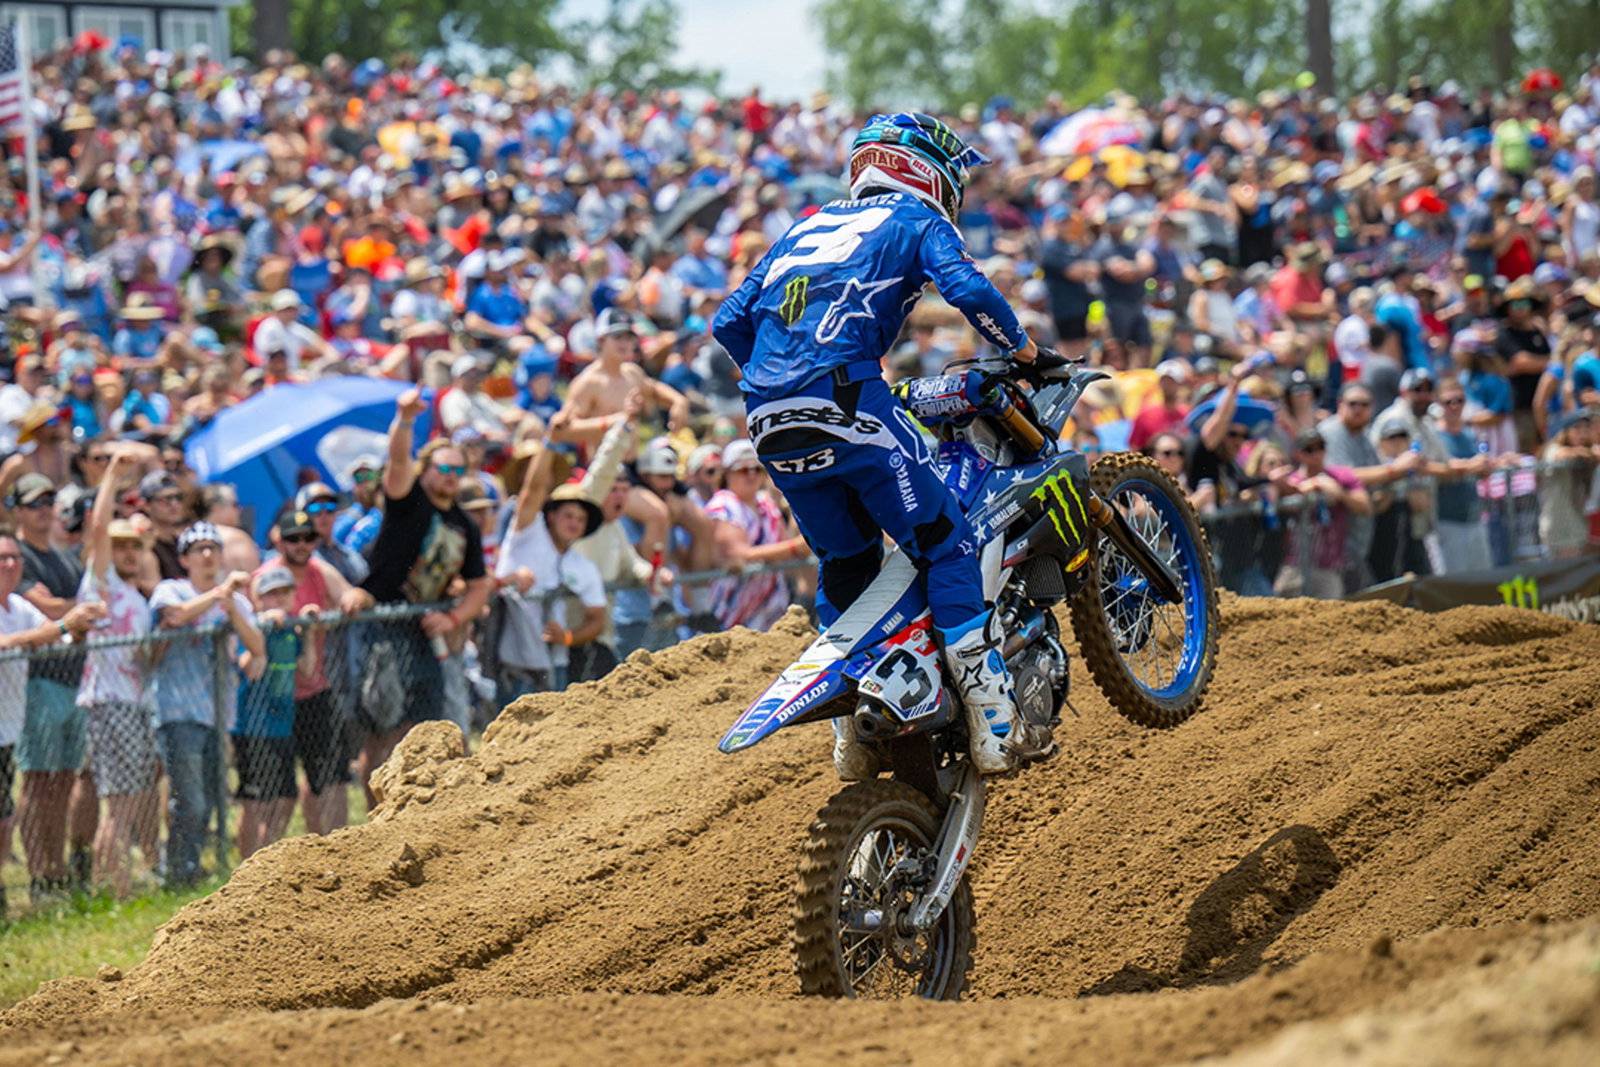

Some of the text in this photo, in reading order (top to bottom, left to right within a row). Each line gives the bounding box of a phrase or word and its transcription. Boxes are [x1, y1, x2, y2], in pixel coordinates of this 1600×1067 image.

[912, 159, 932, 177] BELL
[762, 208, 894, 289] 3
[895, 463, 919, 513] YAMAHA
[987, 499, 1022, 530] YAMALUBE
[881, 611, 905, 635] YAMAHA
[875, 647, 933, 711] 3
[775, 680, 830, 724] DUNLOP
